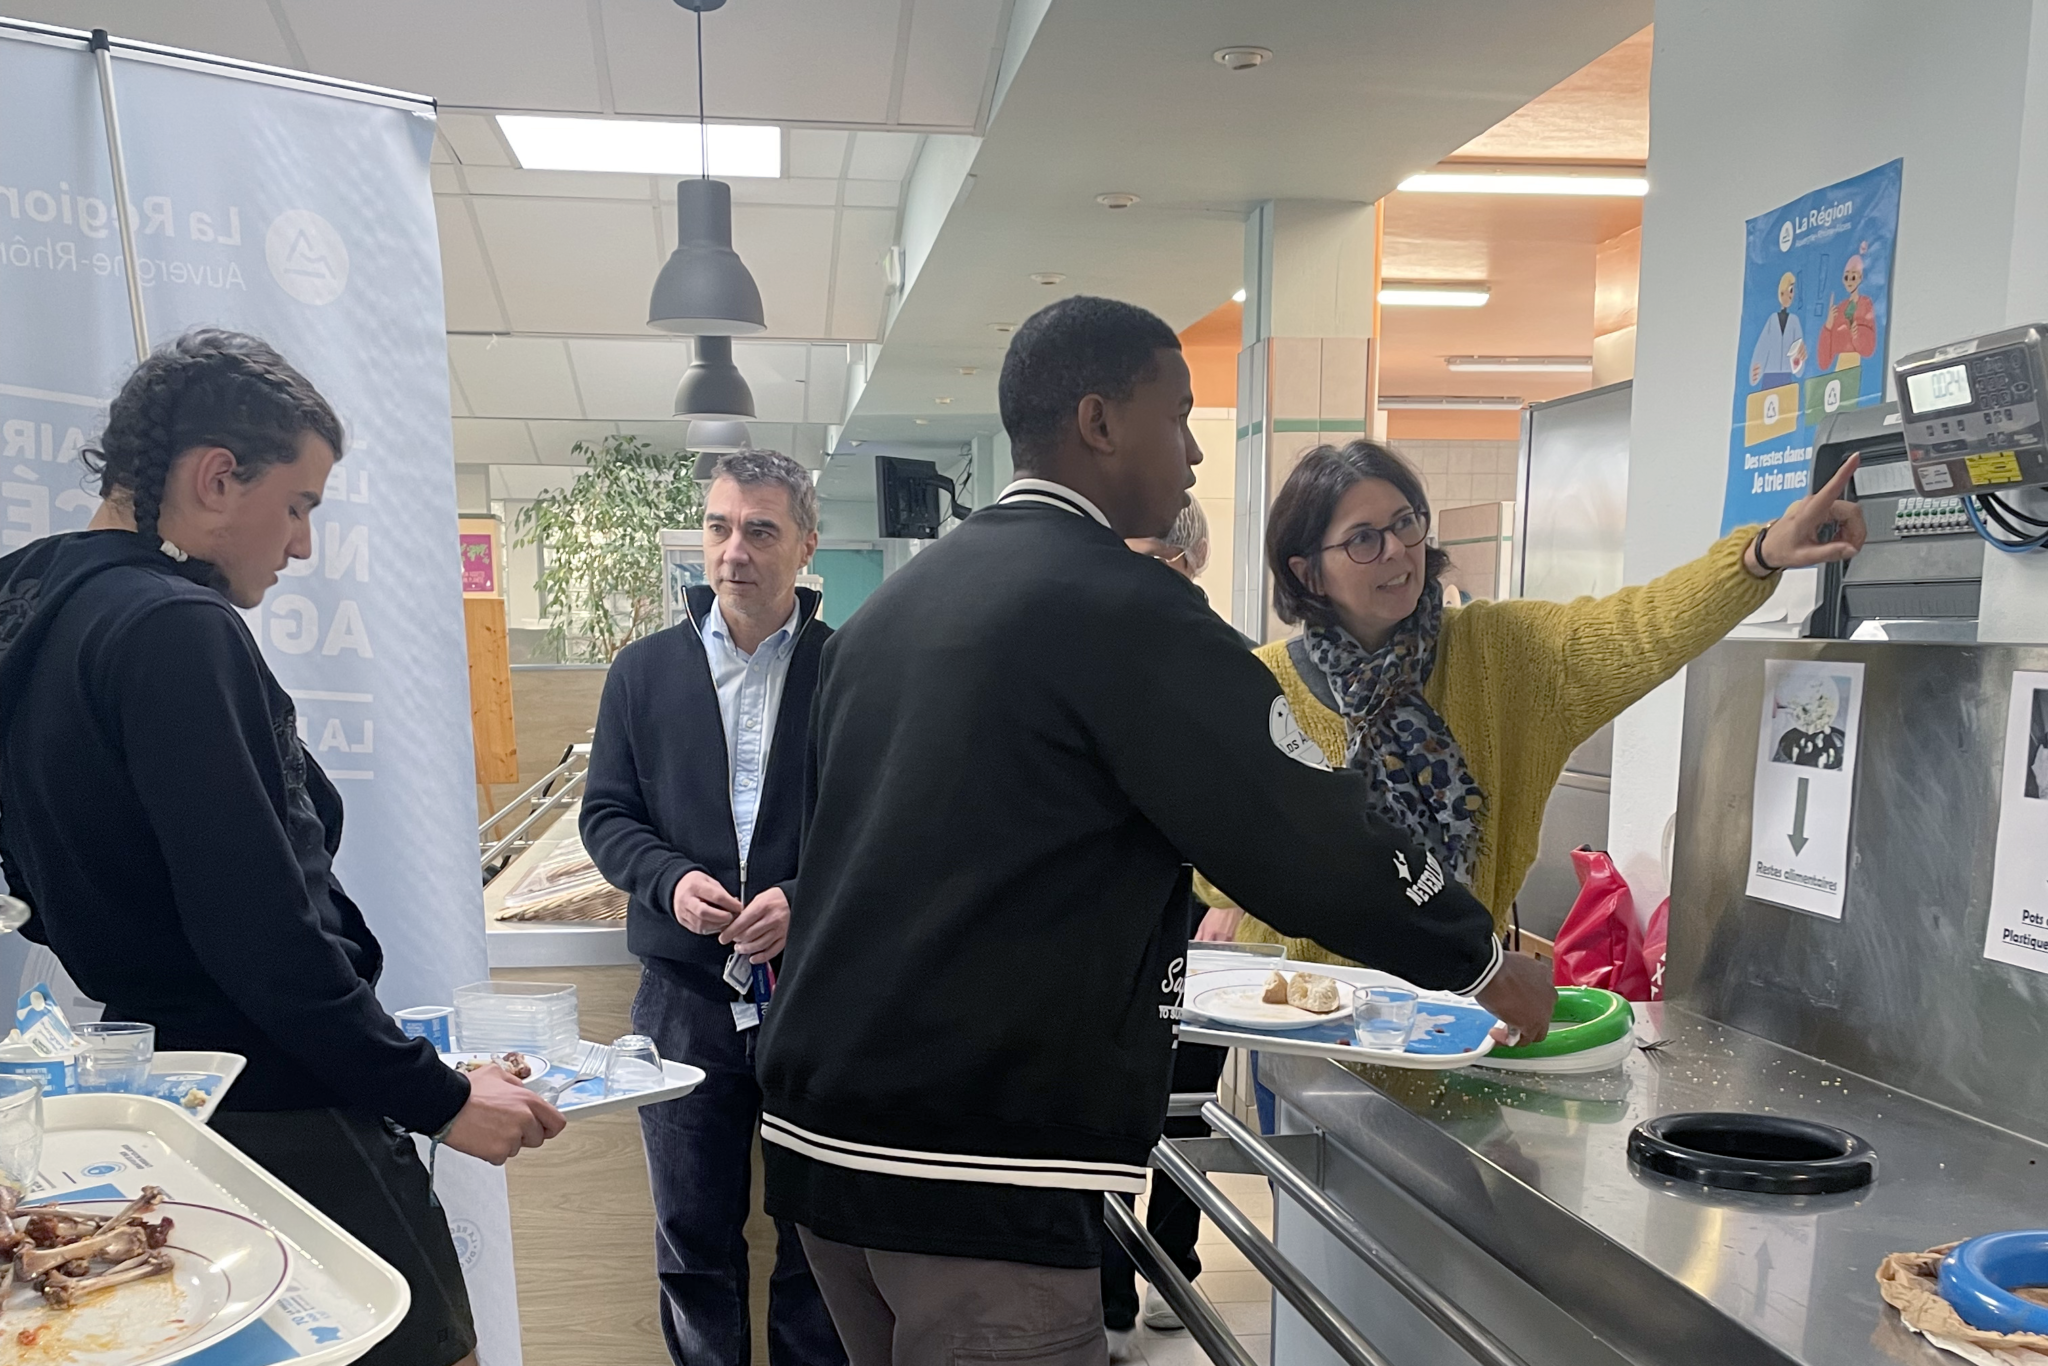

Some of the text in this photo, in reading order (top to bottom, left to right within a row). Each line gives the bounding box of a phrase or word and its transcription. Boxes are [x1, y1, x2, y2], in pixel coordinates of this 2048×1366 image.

[1795, 201, 1853, 234] La Région
[1744, 453, 1759, 470] Des
[1759, 451, 1784, 467] restes
[1784, 445, 1805, 463] dans
[1751, 471, 1764, 494] Je
[1764, 468, 1784, 493] trie
[1784, 470, 1808, 490] mes
[1756, 861, 1838, 891] Restes alimentaires
[2022, 909, 2044, 925] Pots
